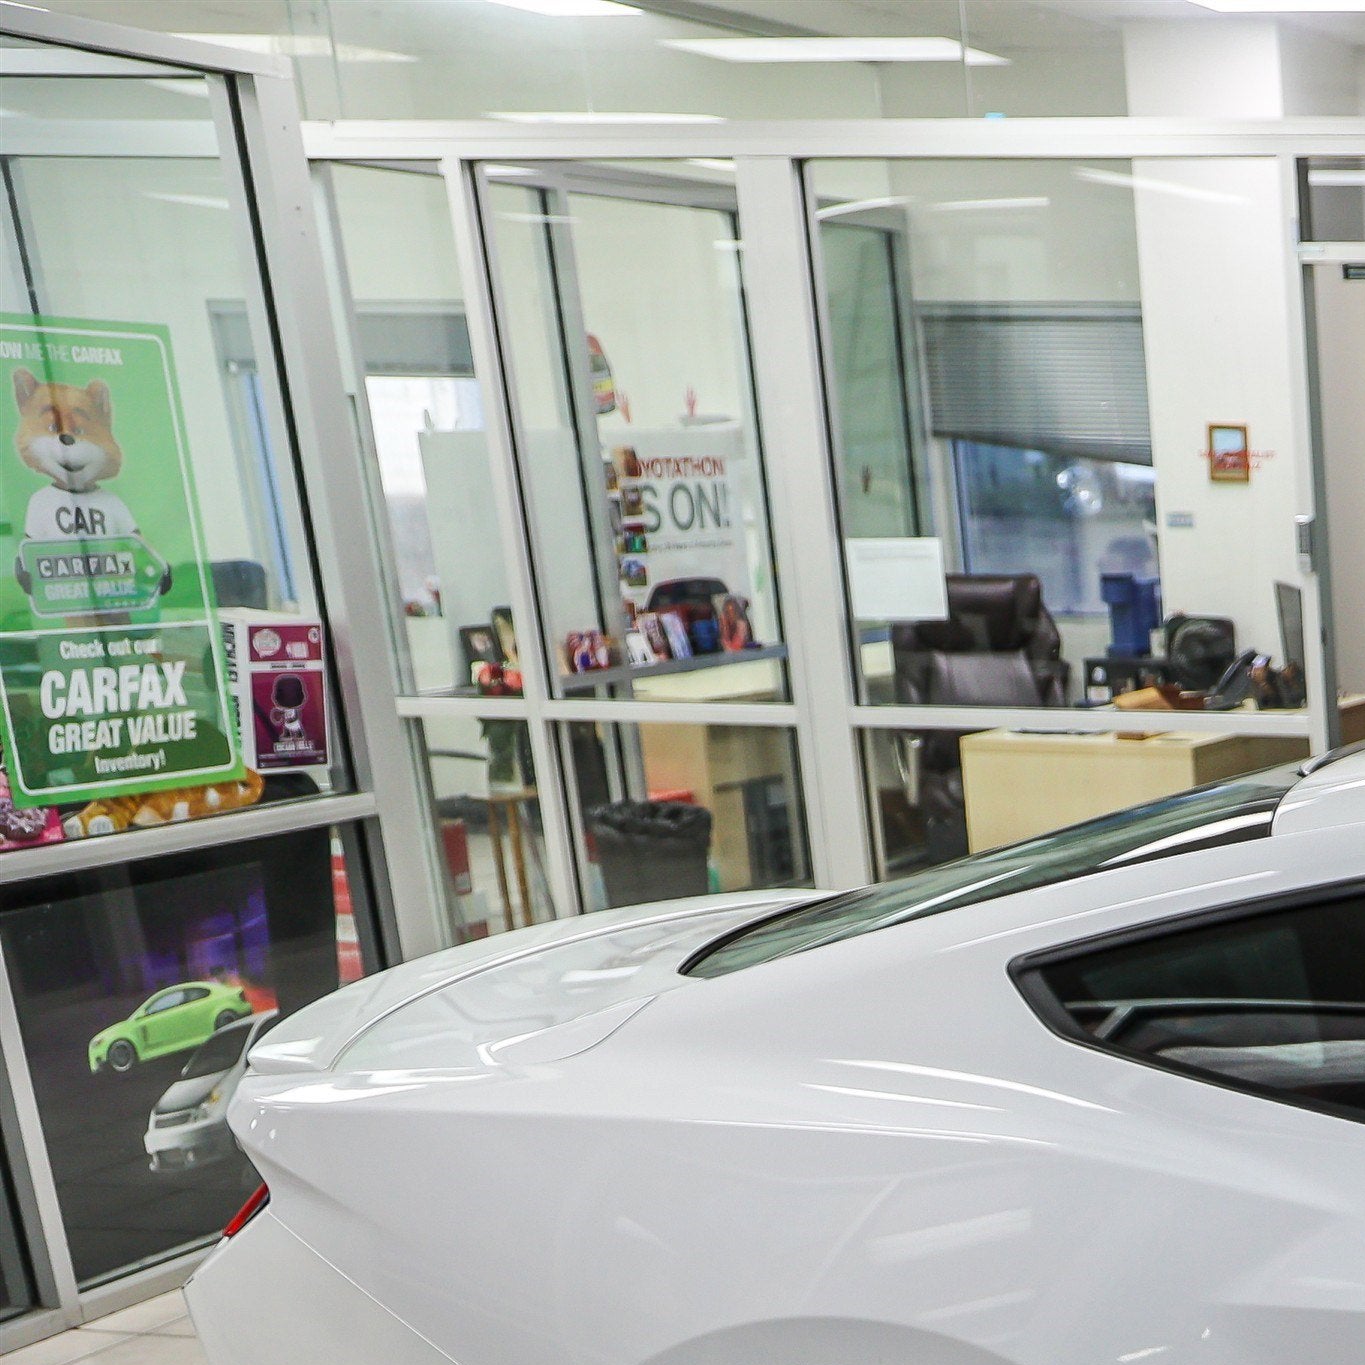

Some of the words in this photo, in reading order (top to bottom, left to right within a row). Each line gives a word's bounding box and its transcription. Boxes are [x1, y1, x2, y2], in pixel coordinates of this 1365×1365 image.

[71, 345, 123, 366] CARFAX
[55, 506, 107, 535] CAR
[37, 553, 134, 579] CARFAX
[44, 581, 90, 600] GREAT
[59, 638, 105, 660] Check
[107, 637, 132, 656] out
[134, 637, 163, 654] our
[40, 660, 188, 720] CARFAX
[48, 717, 124, 755] GREAT
[127, 710, 198, 746] VALUE
[93, 748, 167, 775] Inventory!
